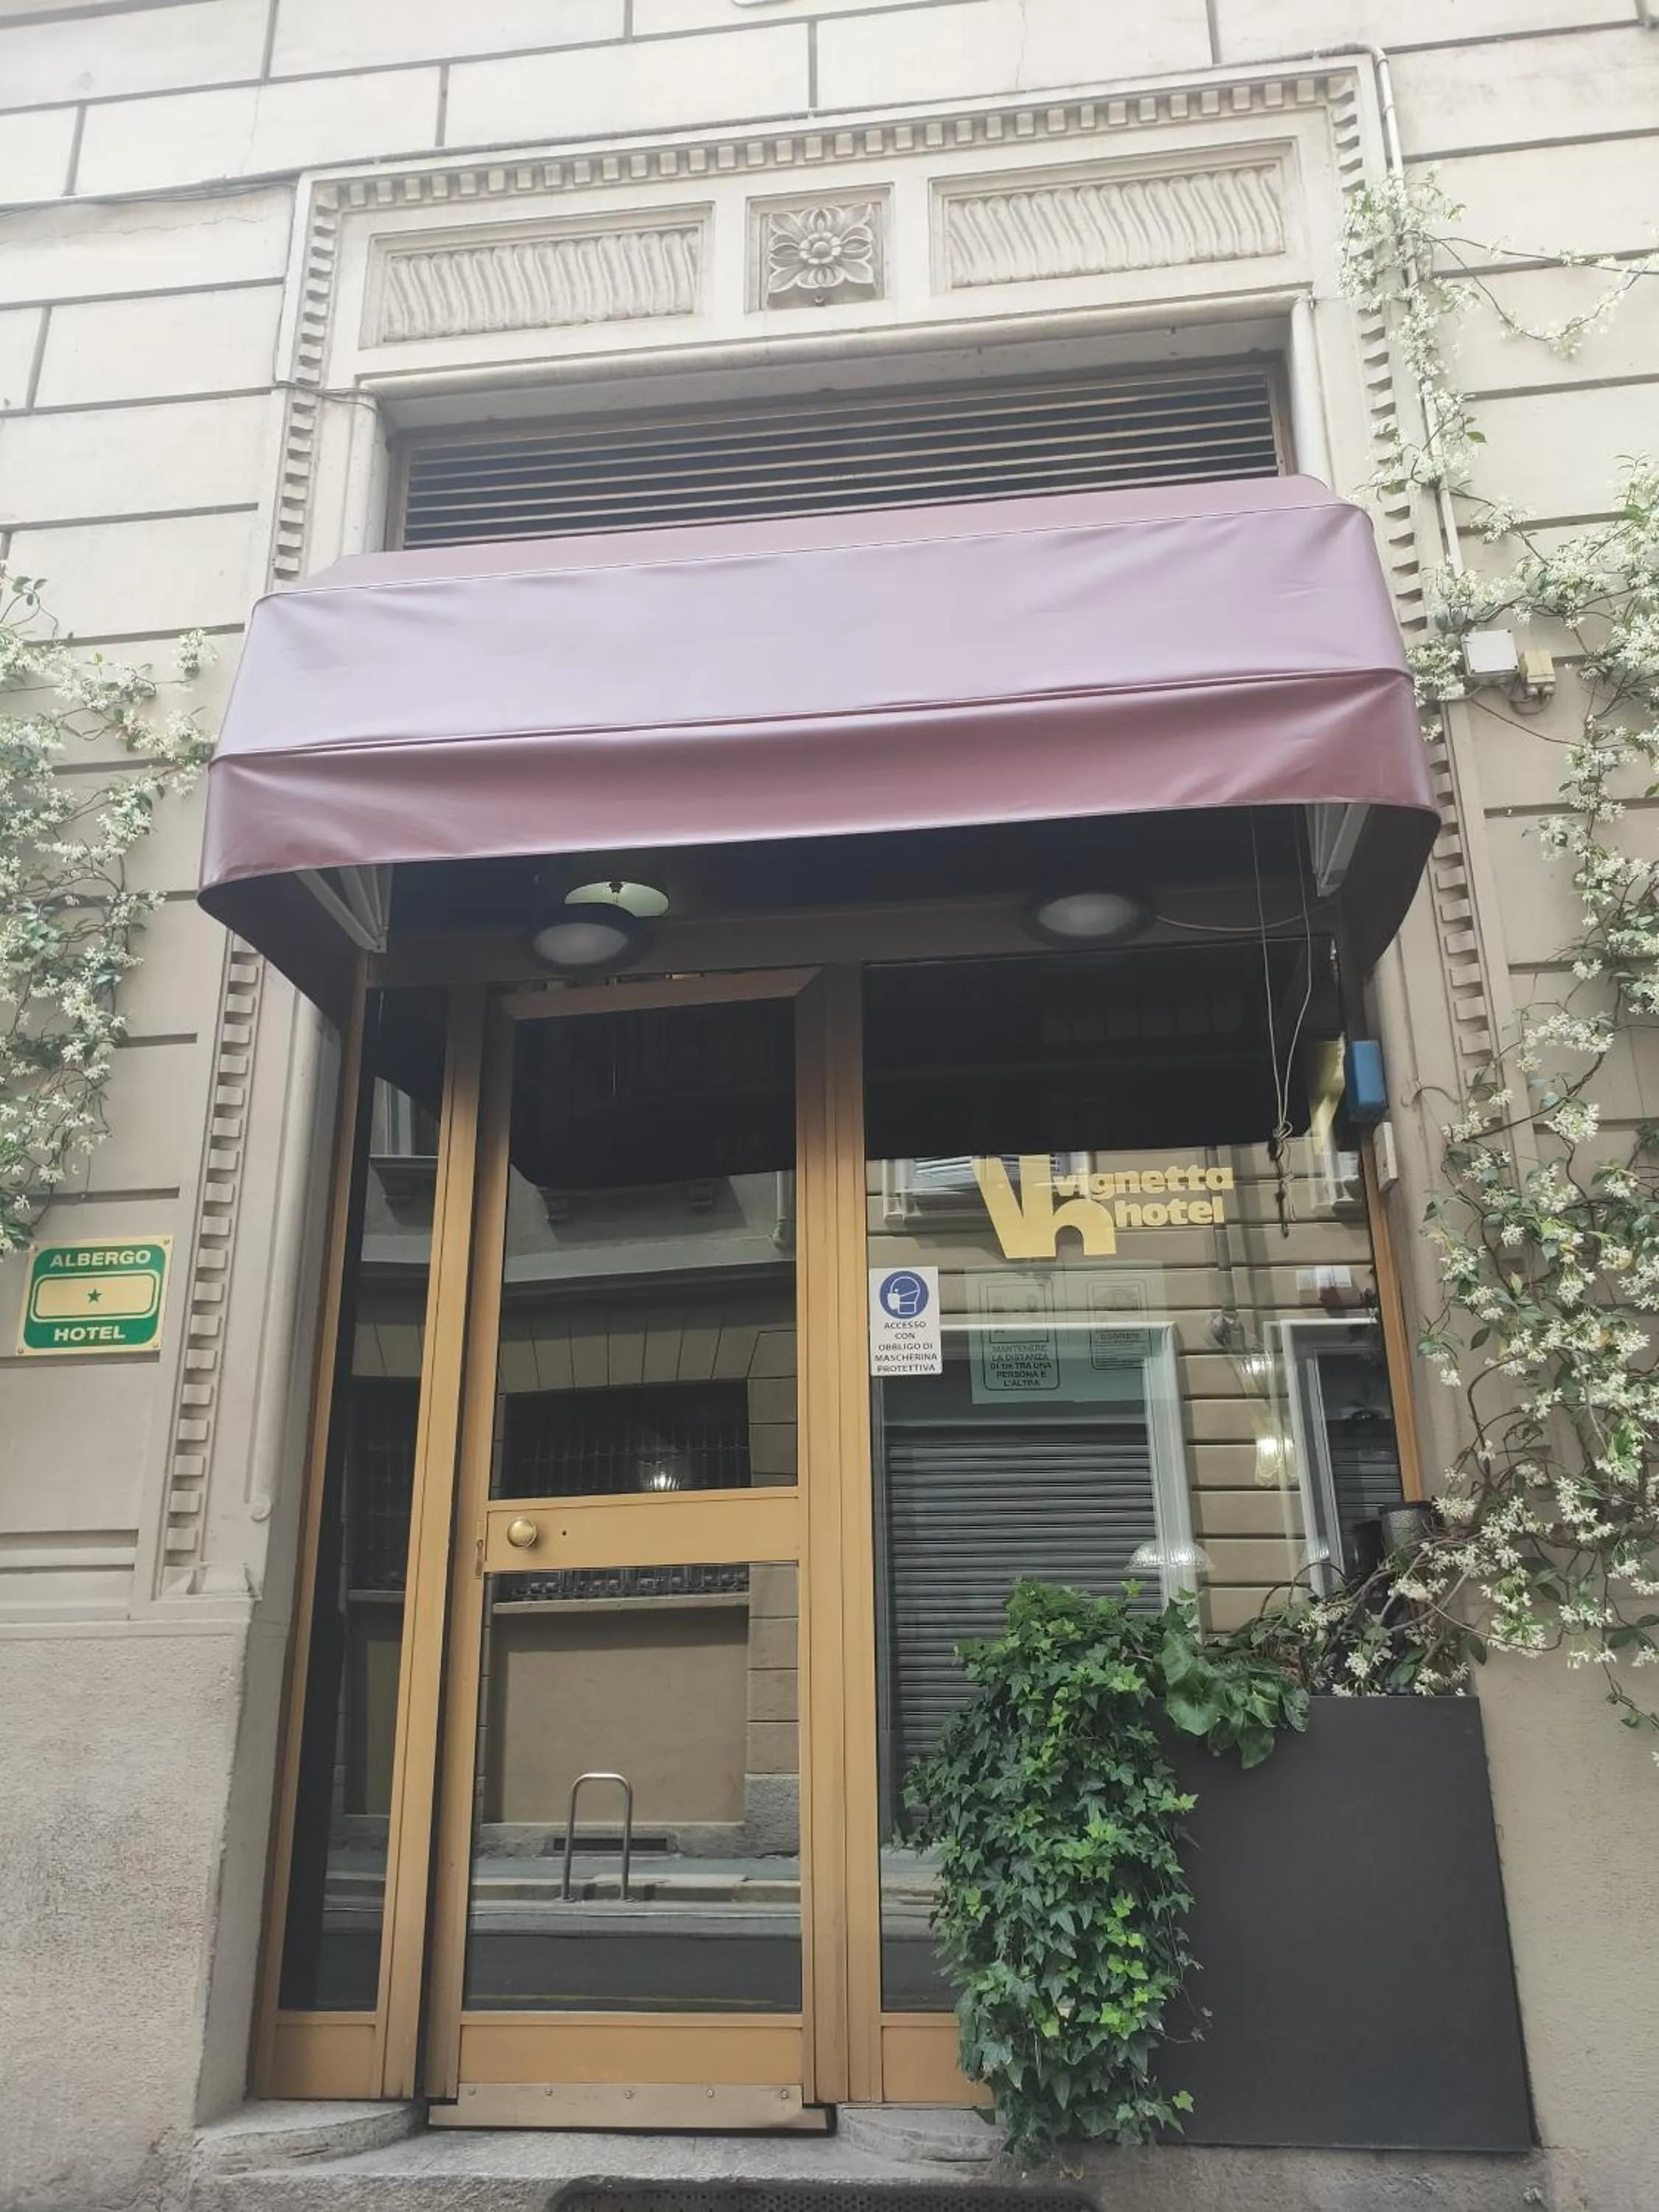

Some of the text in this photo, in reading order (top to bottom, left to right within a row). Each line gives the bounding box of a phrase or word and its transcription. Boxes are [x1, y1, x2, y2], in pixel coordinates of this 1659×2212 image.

[1114, 1196, 1225, 1228] hotel
[49, 1250, 151, 1267] ALBERGO
[884, 1321, 927, 1329] ACCESSO
[54, 1326, 125, 1342] HOTEL
[878, 1343, 921, 1352] OBBLIGO
[874, 1353, 937, 1362] MASCHERINA
[877, 1364, 936, 1372] PROTETTIVA
